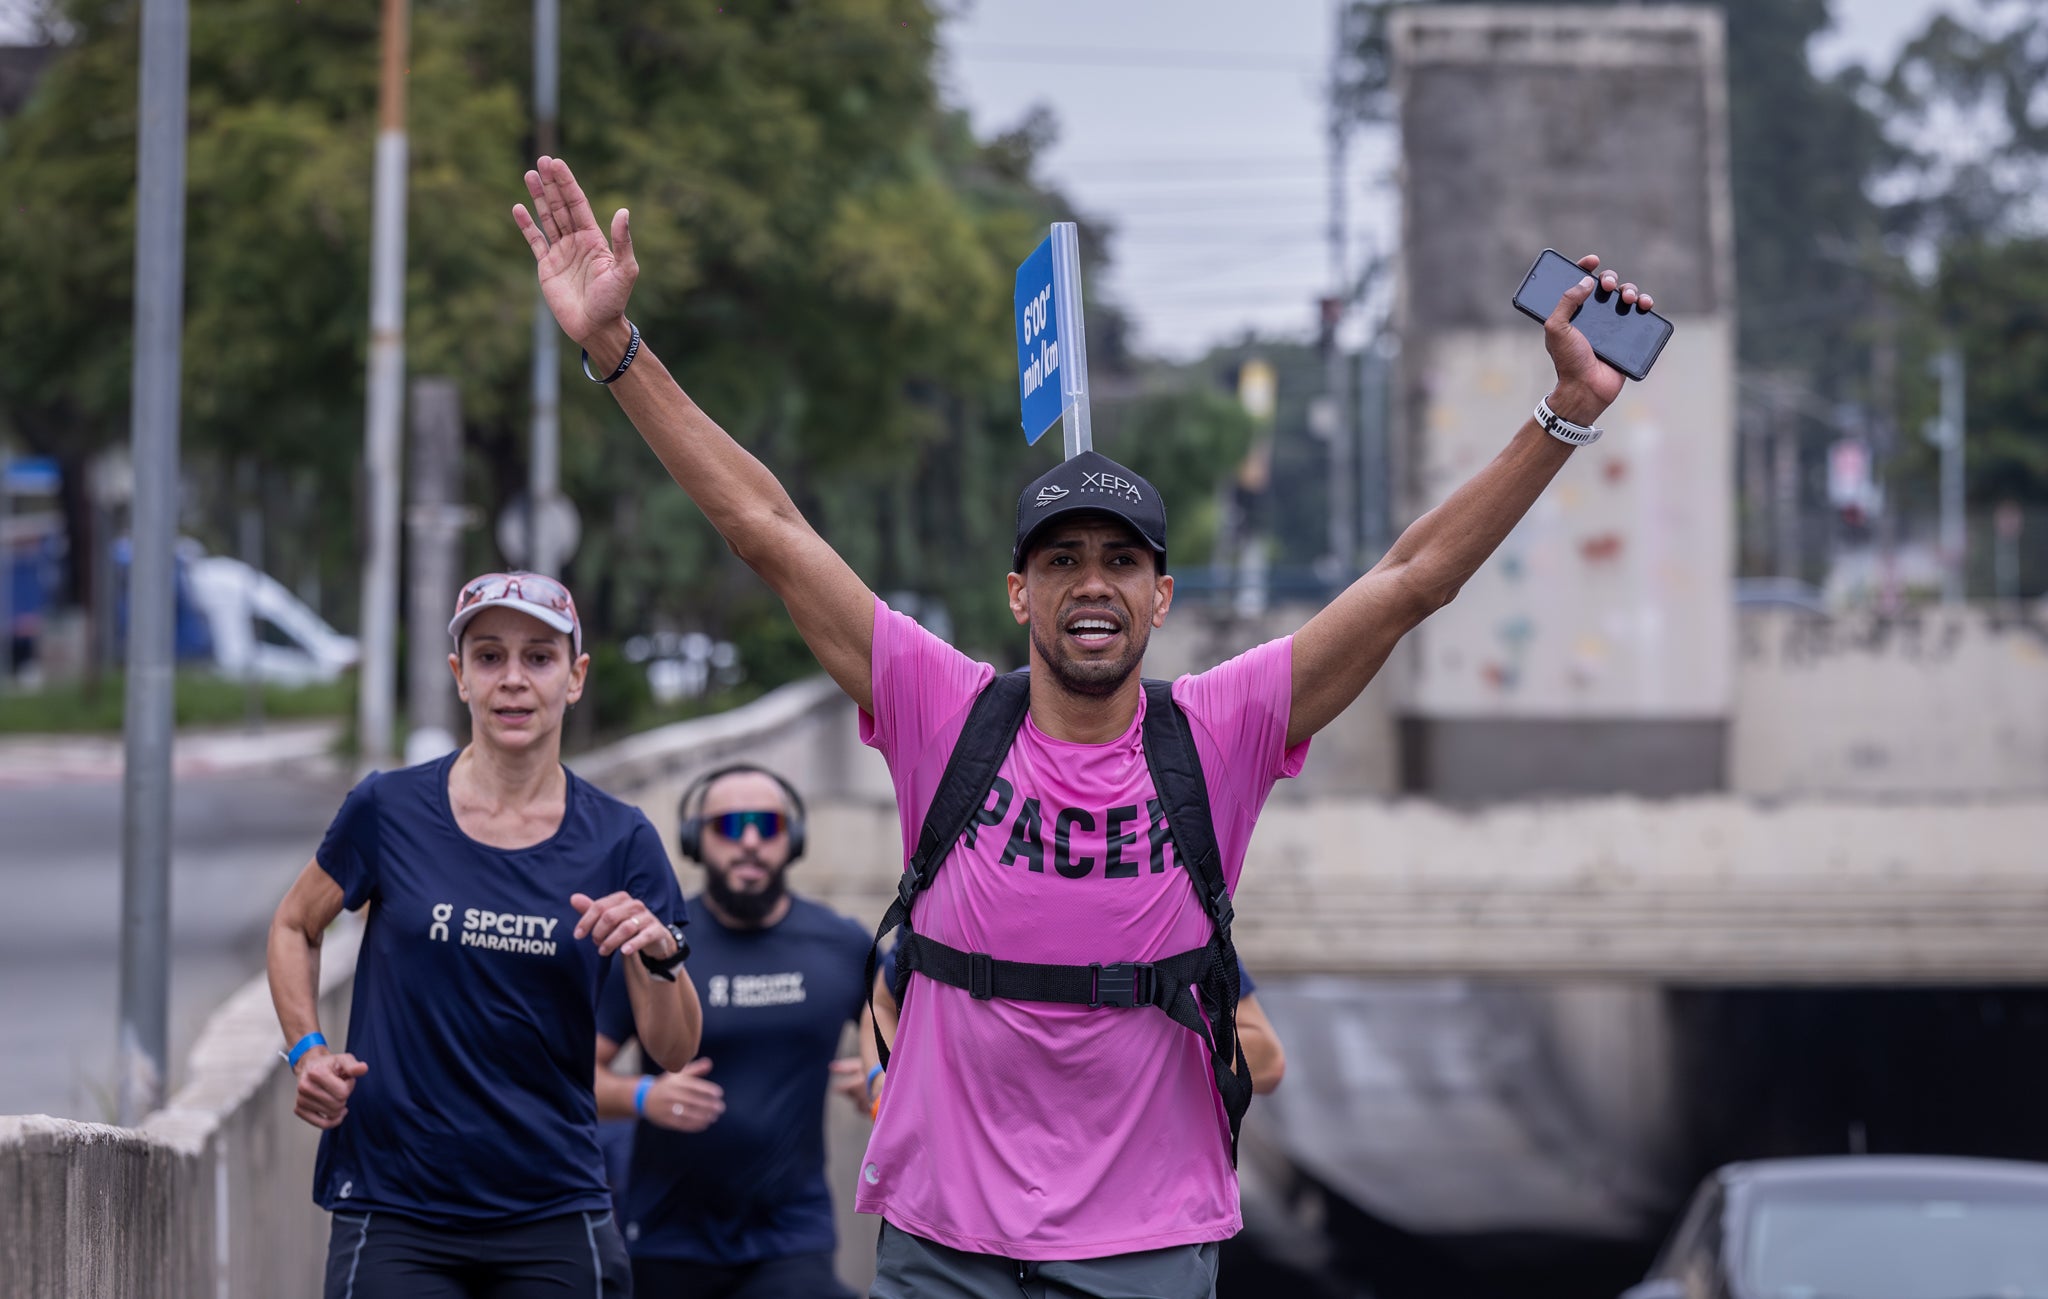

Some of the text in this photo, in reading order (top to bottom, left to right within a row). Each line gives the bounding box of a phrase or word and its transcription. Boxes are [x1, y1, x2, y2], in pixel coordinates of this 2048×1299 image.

[1023, 339, 1059, 399] min/km
[1081, 471, 1142, 501] XEPA
[462, 907, 559, 939] SPCITY
[460, 930, 557, 956] MARATHON
